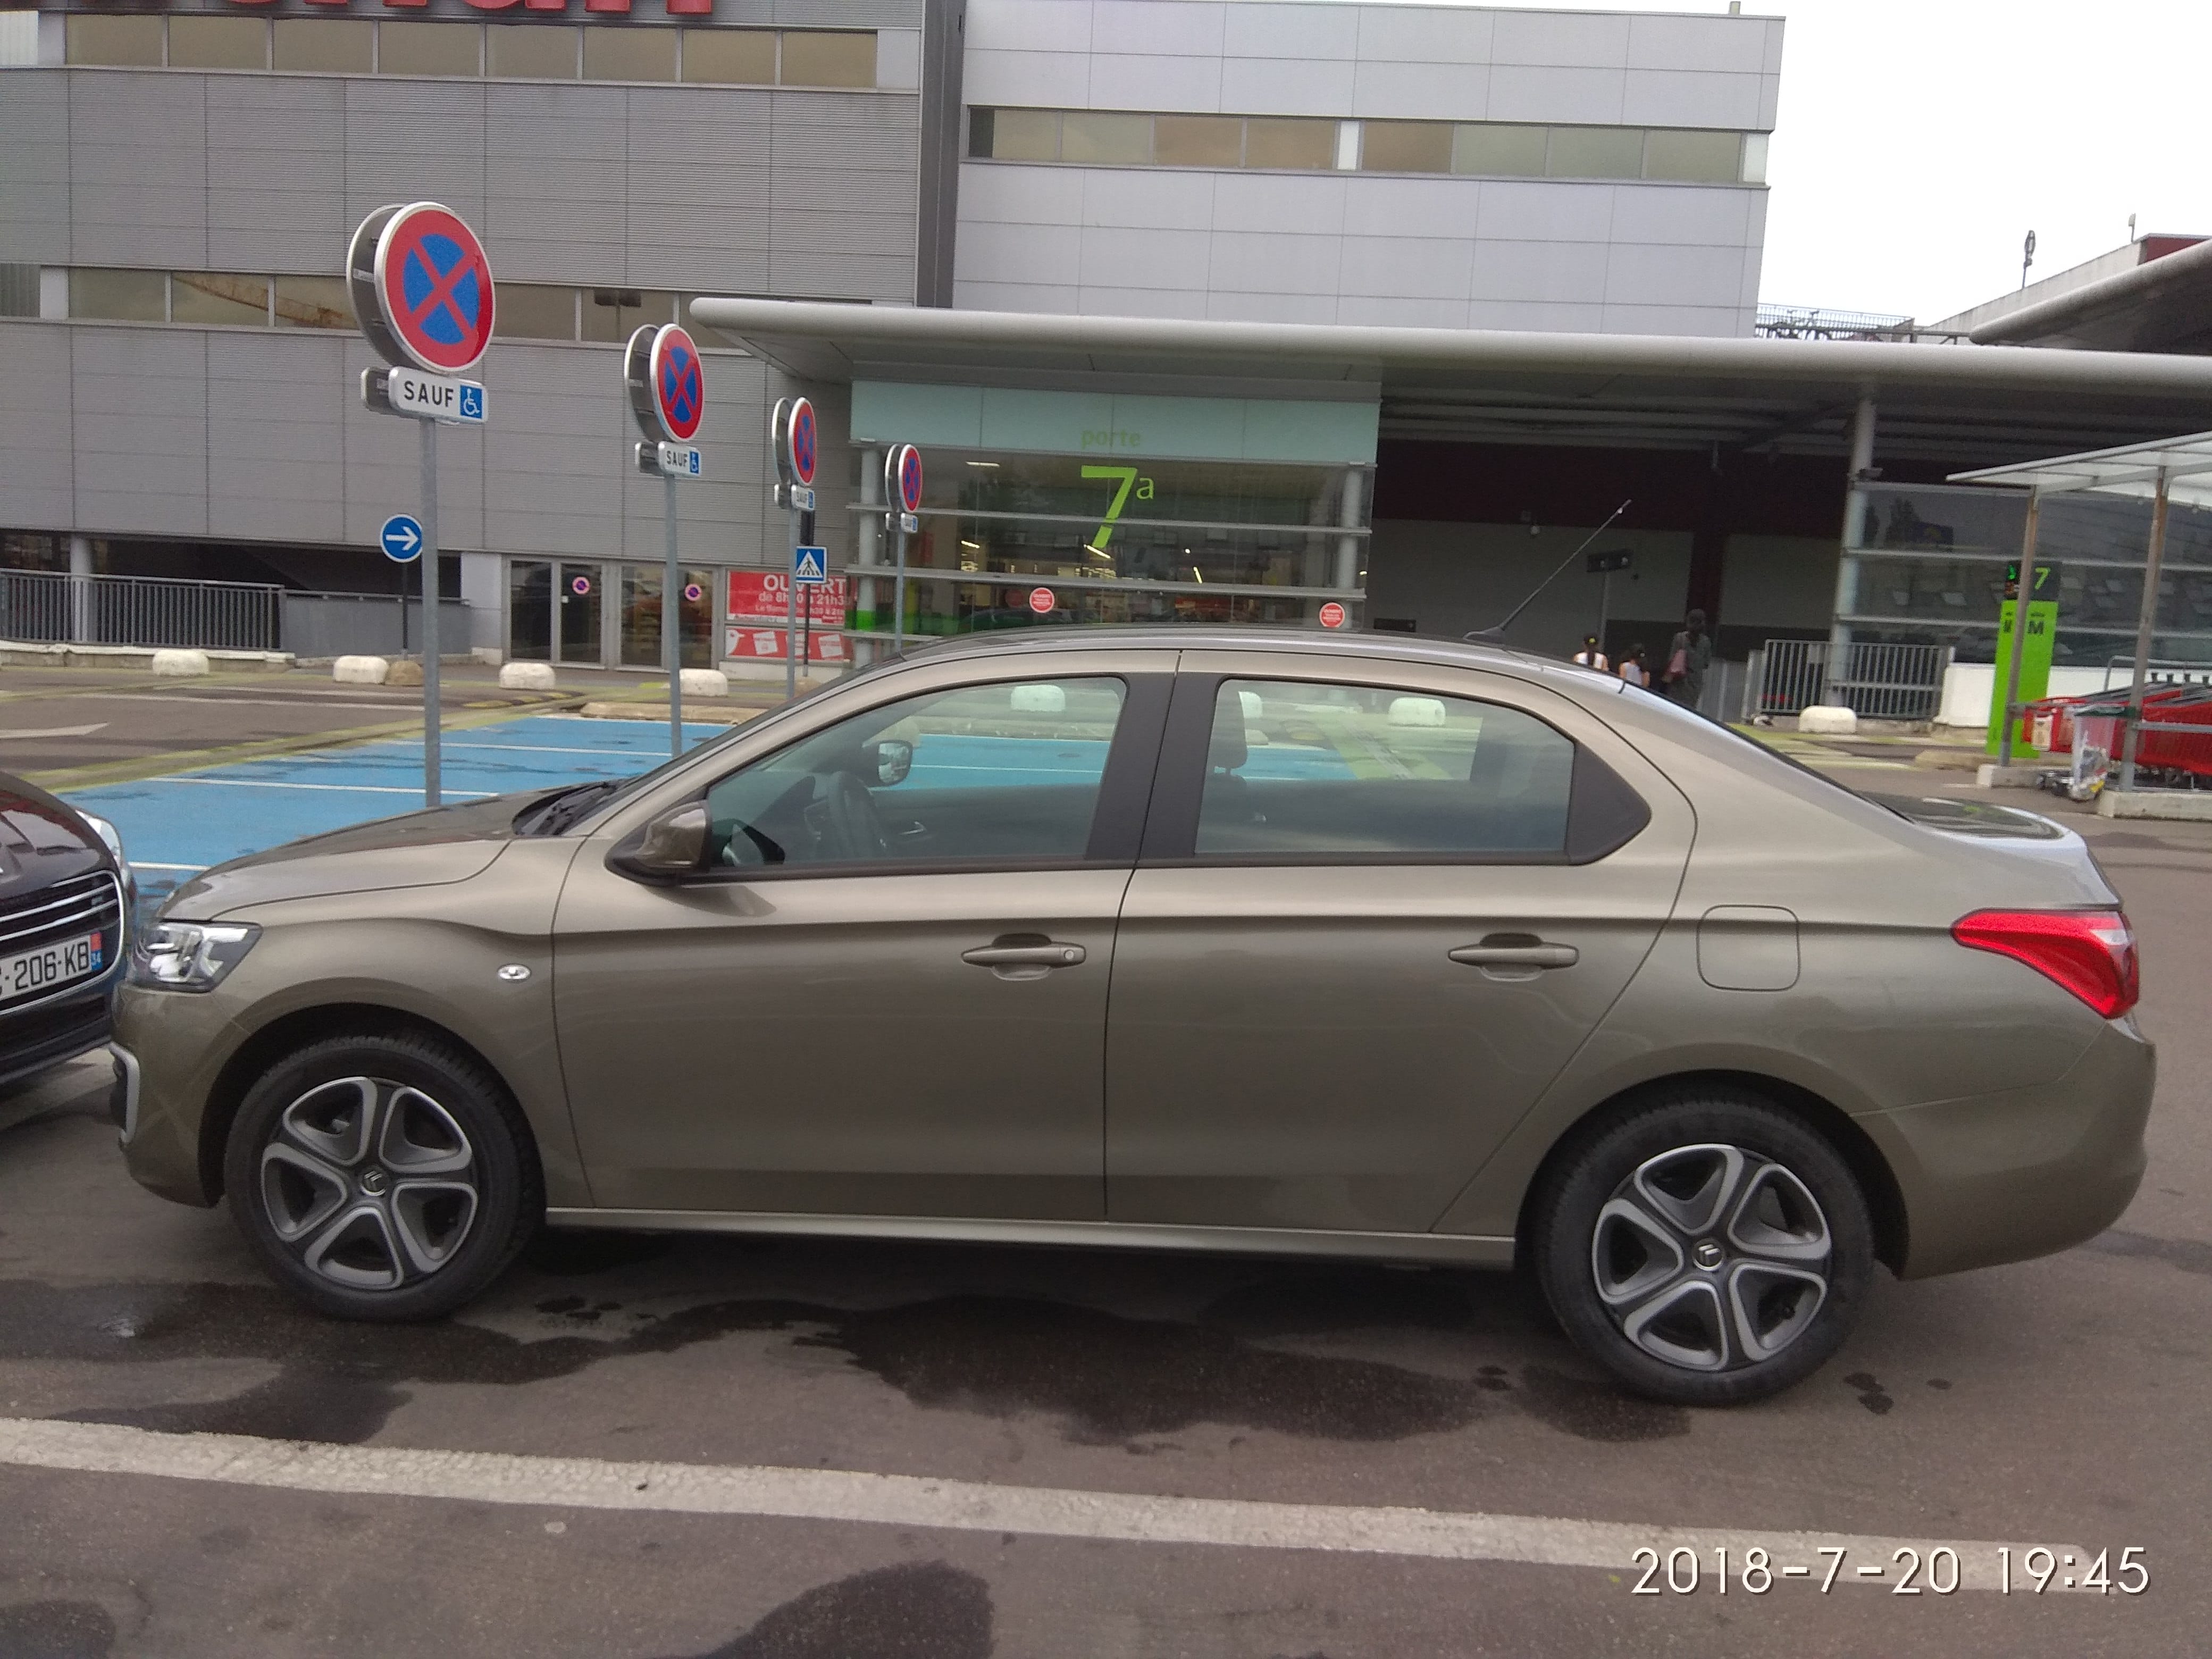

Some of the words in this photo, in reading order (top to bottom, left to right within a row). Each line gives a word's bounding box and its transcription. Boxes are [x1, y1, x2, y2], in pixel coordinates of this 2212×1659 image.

[404, 380, 454, 408] SAUF
[1080, 429, 1141, 450] porte
[666, 450, 688, 467] SAUF
[2034, 566, 2051, 590] 7
[776, 592, 804, 604] 8h0
[0, 942, 89, 995] -206-KB
